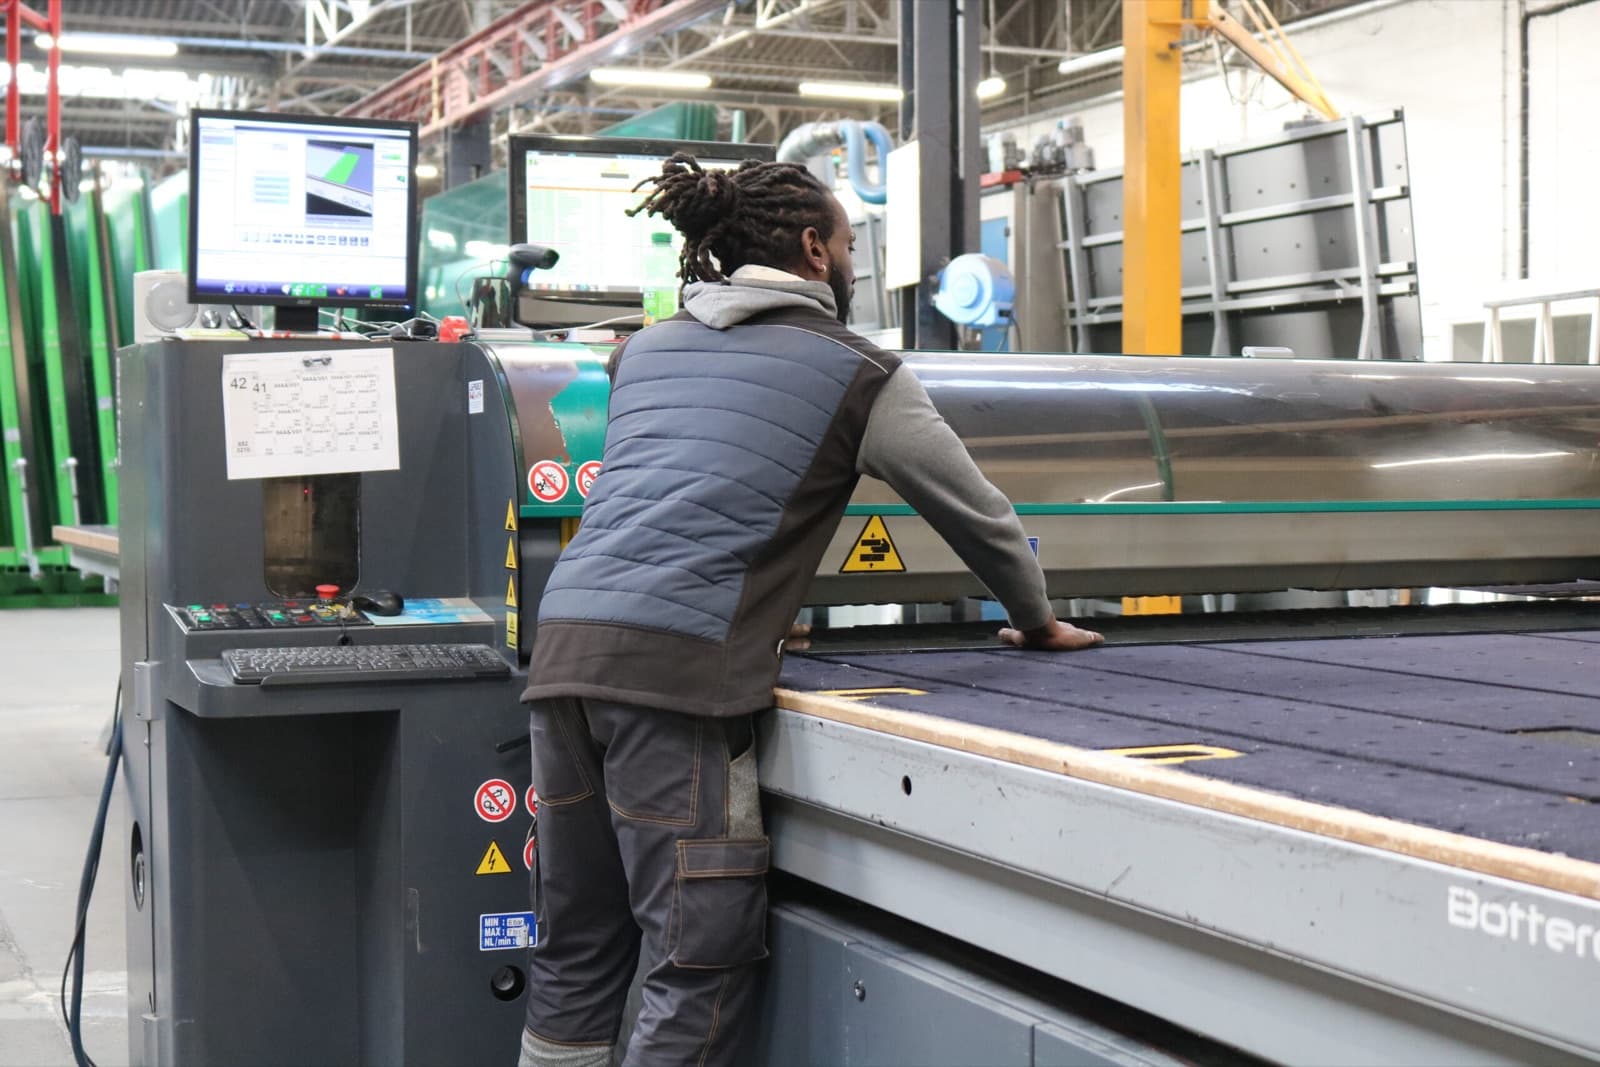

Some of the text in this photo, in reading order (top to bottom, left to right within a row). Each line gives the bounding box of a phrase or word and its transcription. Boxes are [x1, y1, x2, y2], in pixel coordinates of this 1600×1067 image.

[230, 377, 248, 390] 42
[252, 383, 267, 393] 41
[484, 917, 499, 927] MIN
[484, 927, 501, 937] MAX
